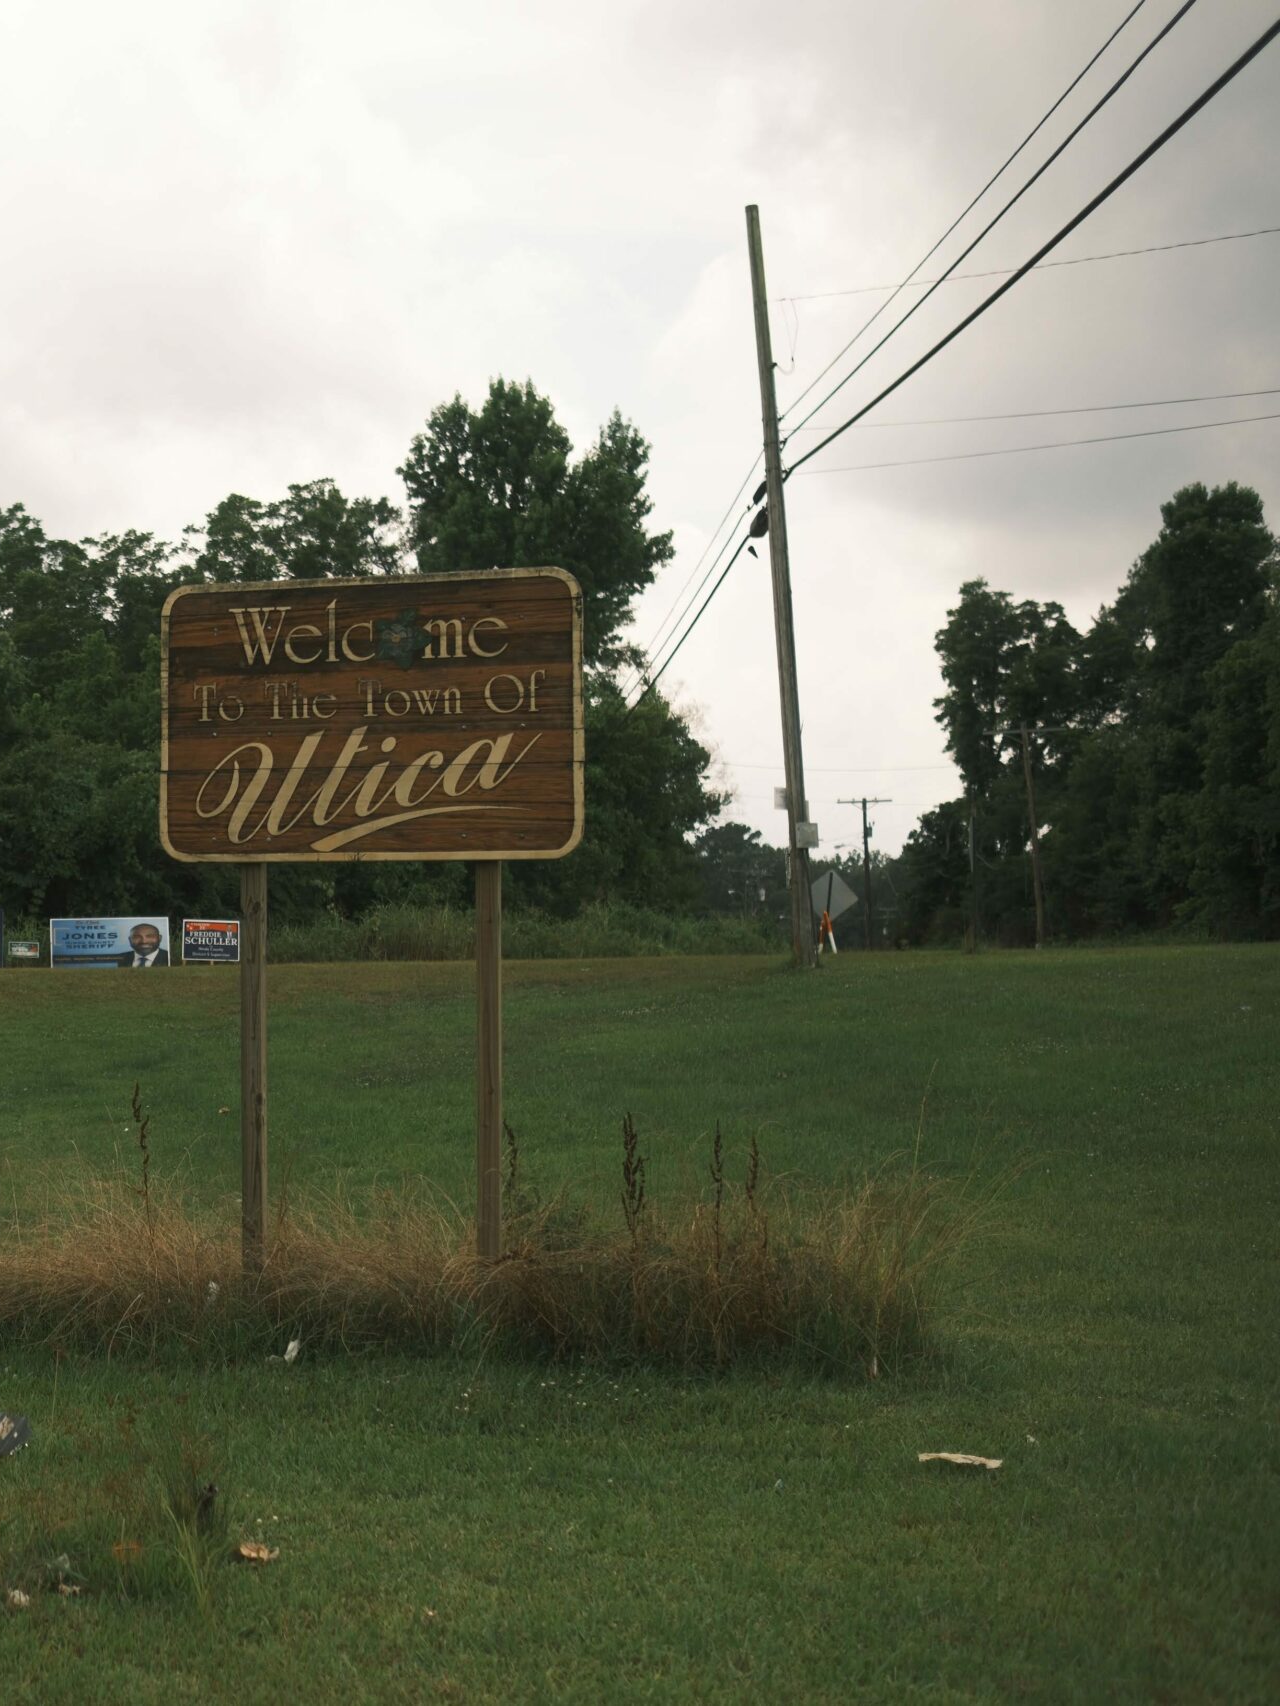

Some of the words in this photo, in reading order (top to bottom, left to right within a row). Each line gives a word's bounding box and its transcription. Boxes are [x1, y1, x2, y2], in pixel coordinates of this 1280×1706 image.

[193, 683, 245, 722] To
[265, 680, 338, 720] The
[357, 678, 463, 718] Town
[484, 669, 546, 714] Of
[196, 726, 542, 845] Utica
[62, 932, 118, 940] JONES
[185, 936, 238, 946] SCHULLER
